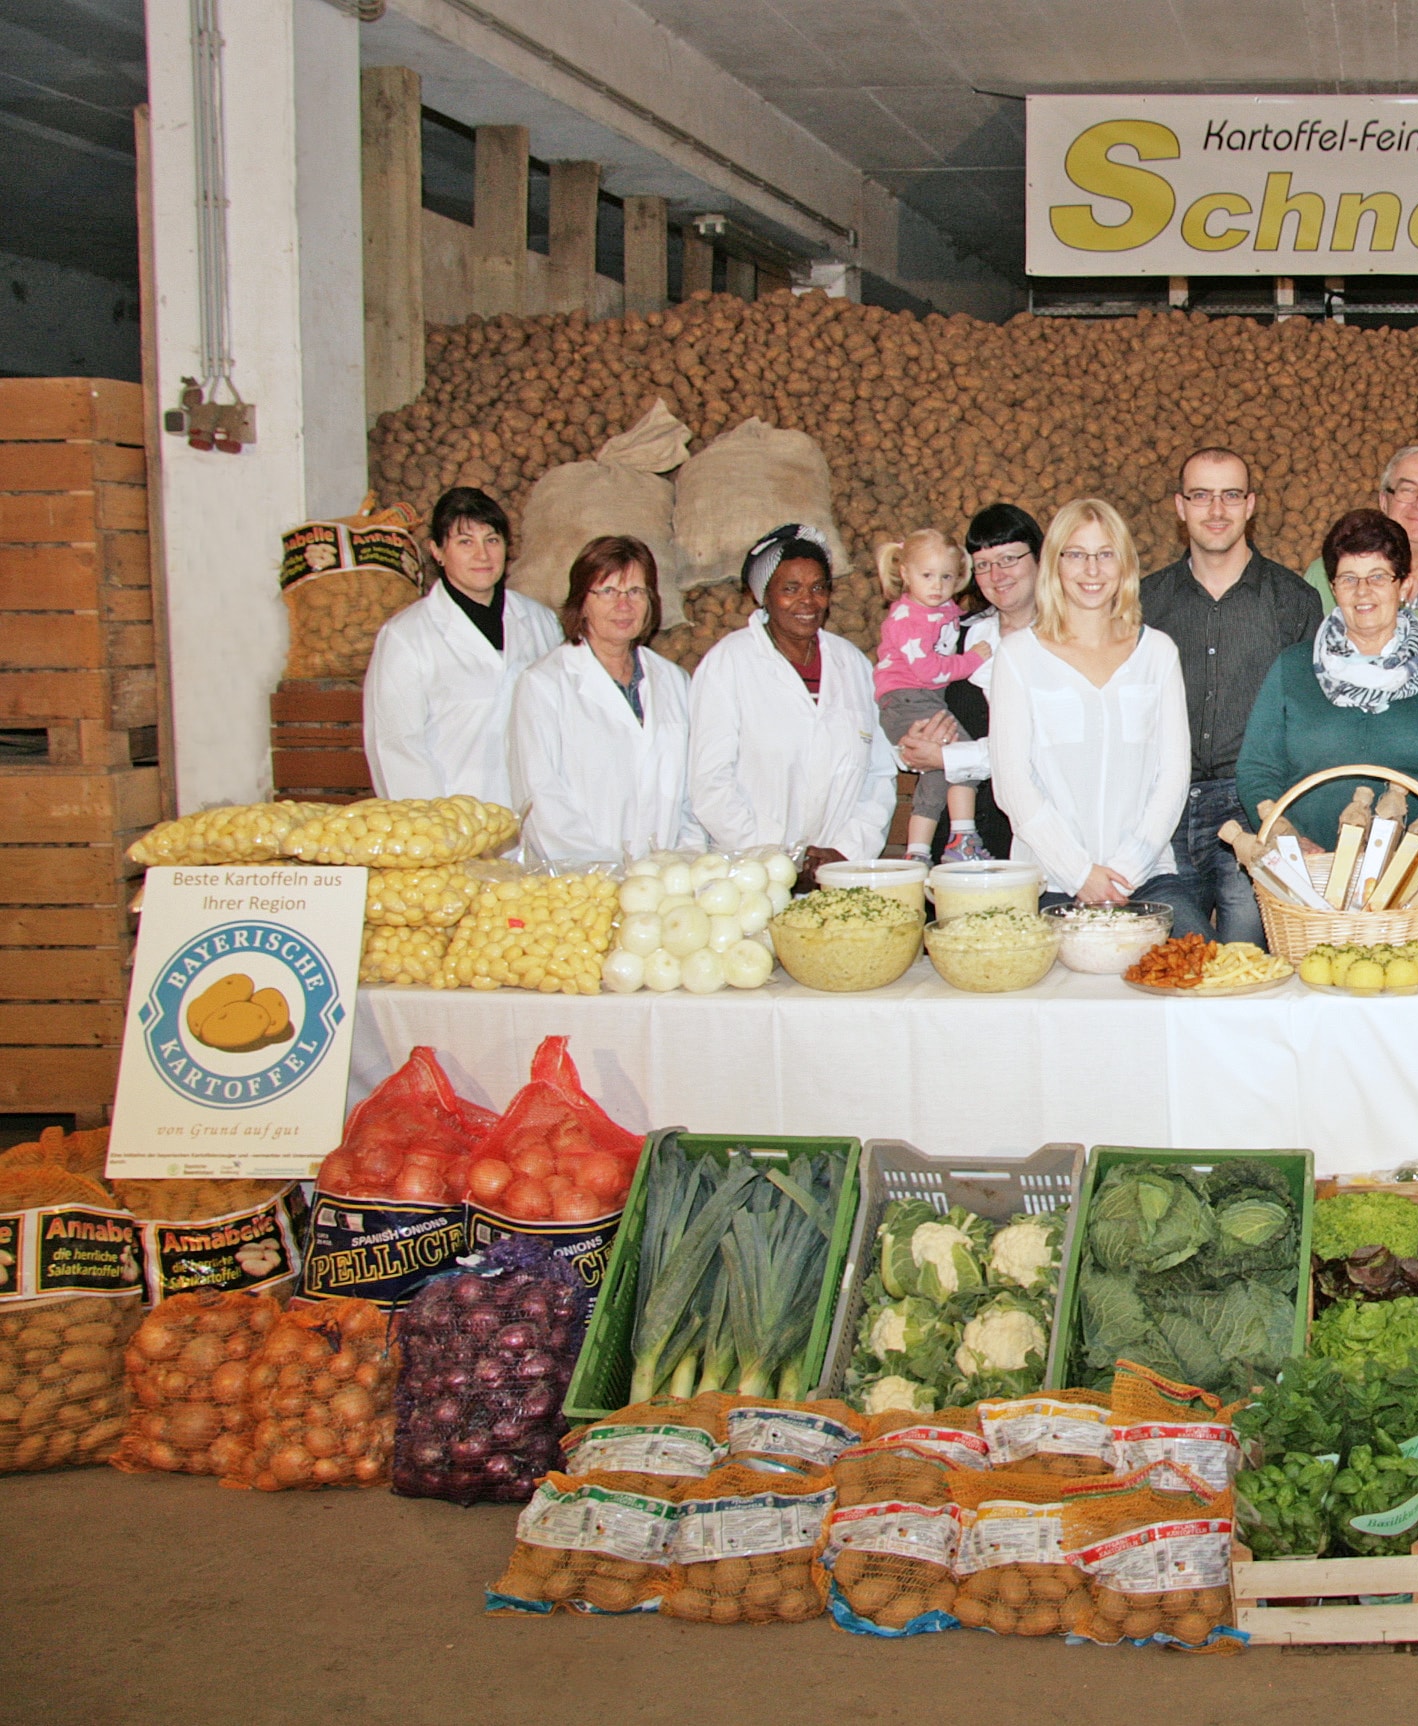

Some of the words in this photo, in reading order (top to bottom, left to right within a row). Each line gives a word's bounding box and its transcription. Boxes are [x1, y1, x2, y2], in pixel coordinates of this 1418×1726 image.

[173, 872, 219, 886] Beste
[224, 872, 308, 886] Kartoffeln
[314, 874, 342, 886] aus
[202, 896, 244, 910] Ihrer
[249, 896, 306, 913] Region
[167, 929, 325, 991] BAYERISCHE
[159, 1038, 318, 1099] KARTOFFEL
[157, 1125, 184, 1135] von
[190, 1122, 238, 1139] Grund
[243, 1122, 269, 1139] auf
[271, 1124, 300, 1139] gut
[163, 1214, 276, 1254] Annabelle
[351, 1229, 399, 1247] SPANISH
[402, 1217, 448, 1236] ONIONS
[53, 1248, 72, 1261] die
[73, 1248, 118, 1262] herrliche
[553, 1236, 603, 1257] ONIONS
